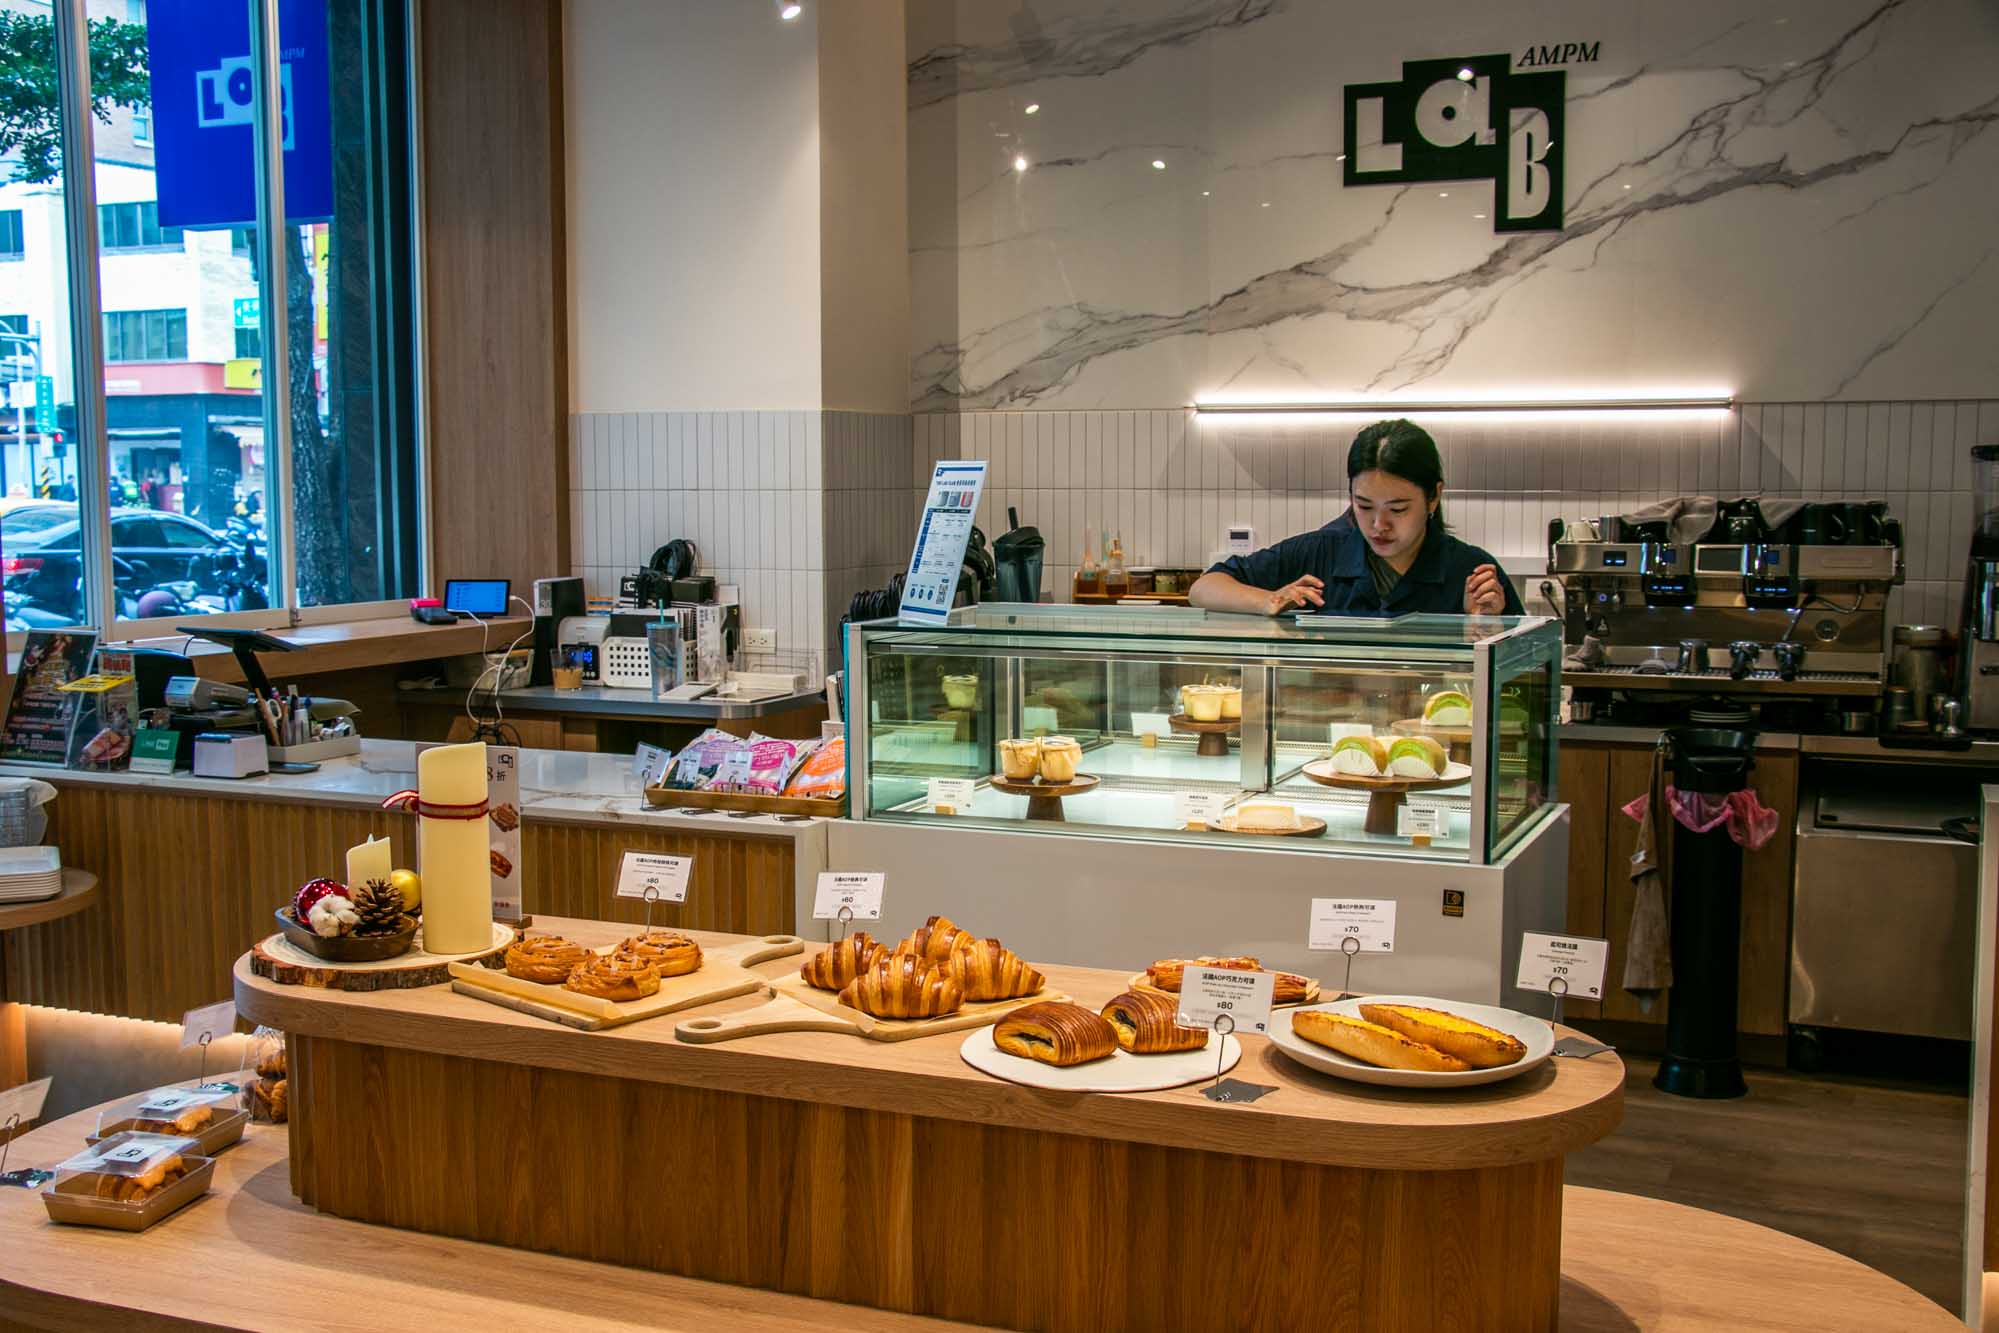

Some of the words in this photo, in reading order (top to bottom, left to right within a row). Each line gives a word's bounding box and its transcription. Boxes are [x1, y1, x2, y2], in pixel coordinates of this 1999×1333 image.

[1517, 41, 1601, 67] AMPM
[496, 770, 506, 782] 折
[1553, 966, 1568, 975] $70
[1217, 1001, 1233, 1010] $80
